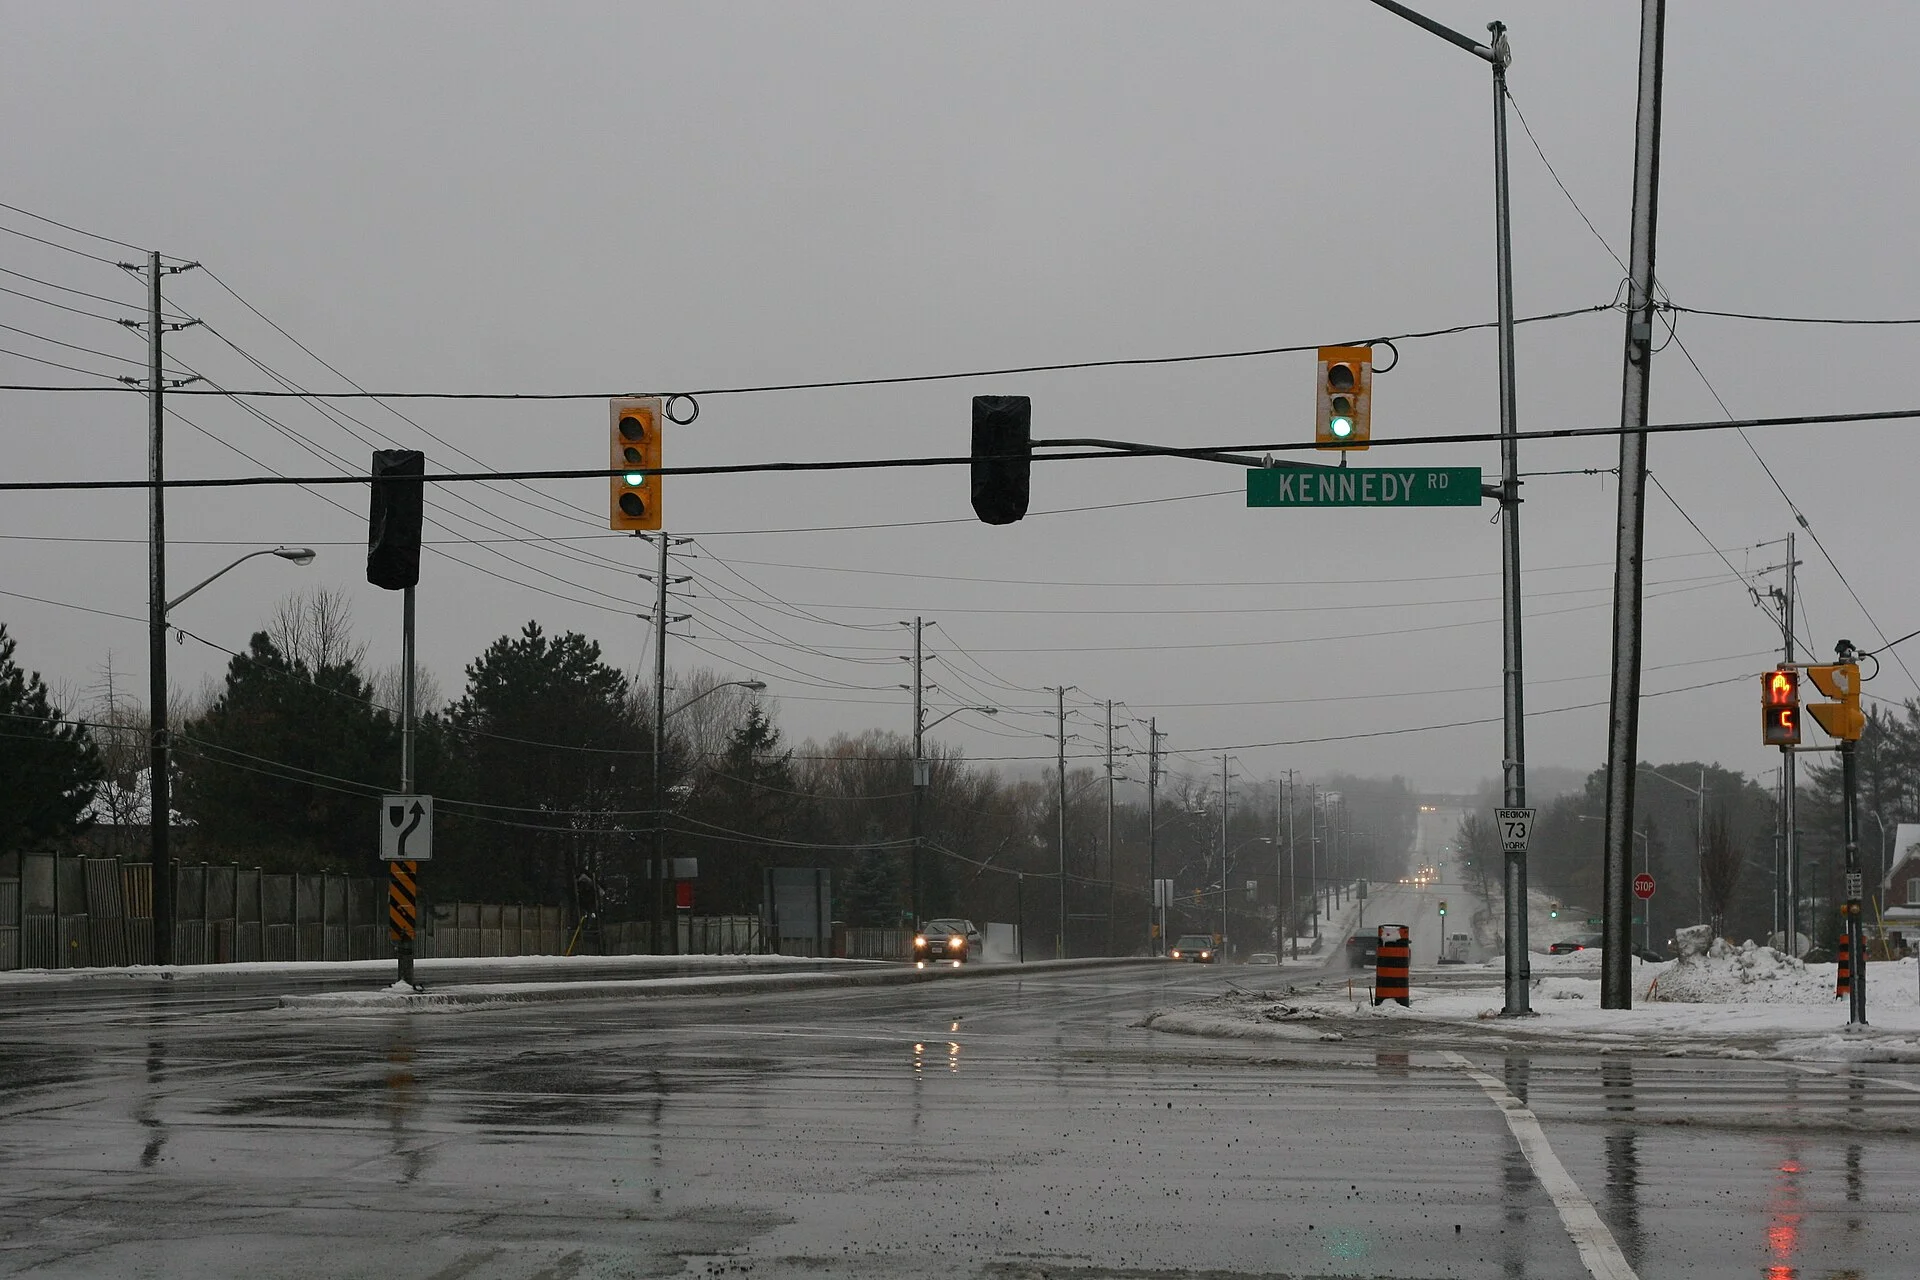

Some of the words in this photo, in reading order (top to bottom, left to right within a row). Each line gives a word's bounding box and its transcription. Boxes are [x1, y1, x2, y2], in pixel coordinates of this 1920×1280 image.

[1279, 473, 1416, 502] KENNEDY
[1428, 473, 1449, 489] RD
[1500, 810, 1530, 819] REGION
[1505, 822, 1526, 838] 73
[1504, 841, 1526, 849] YORK
[1635, 880, 1654, 891] STOP
